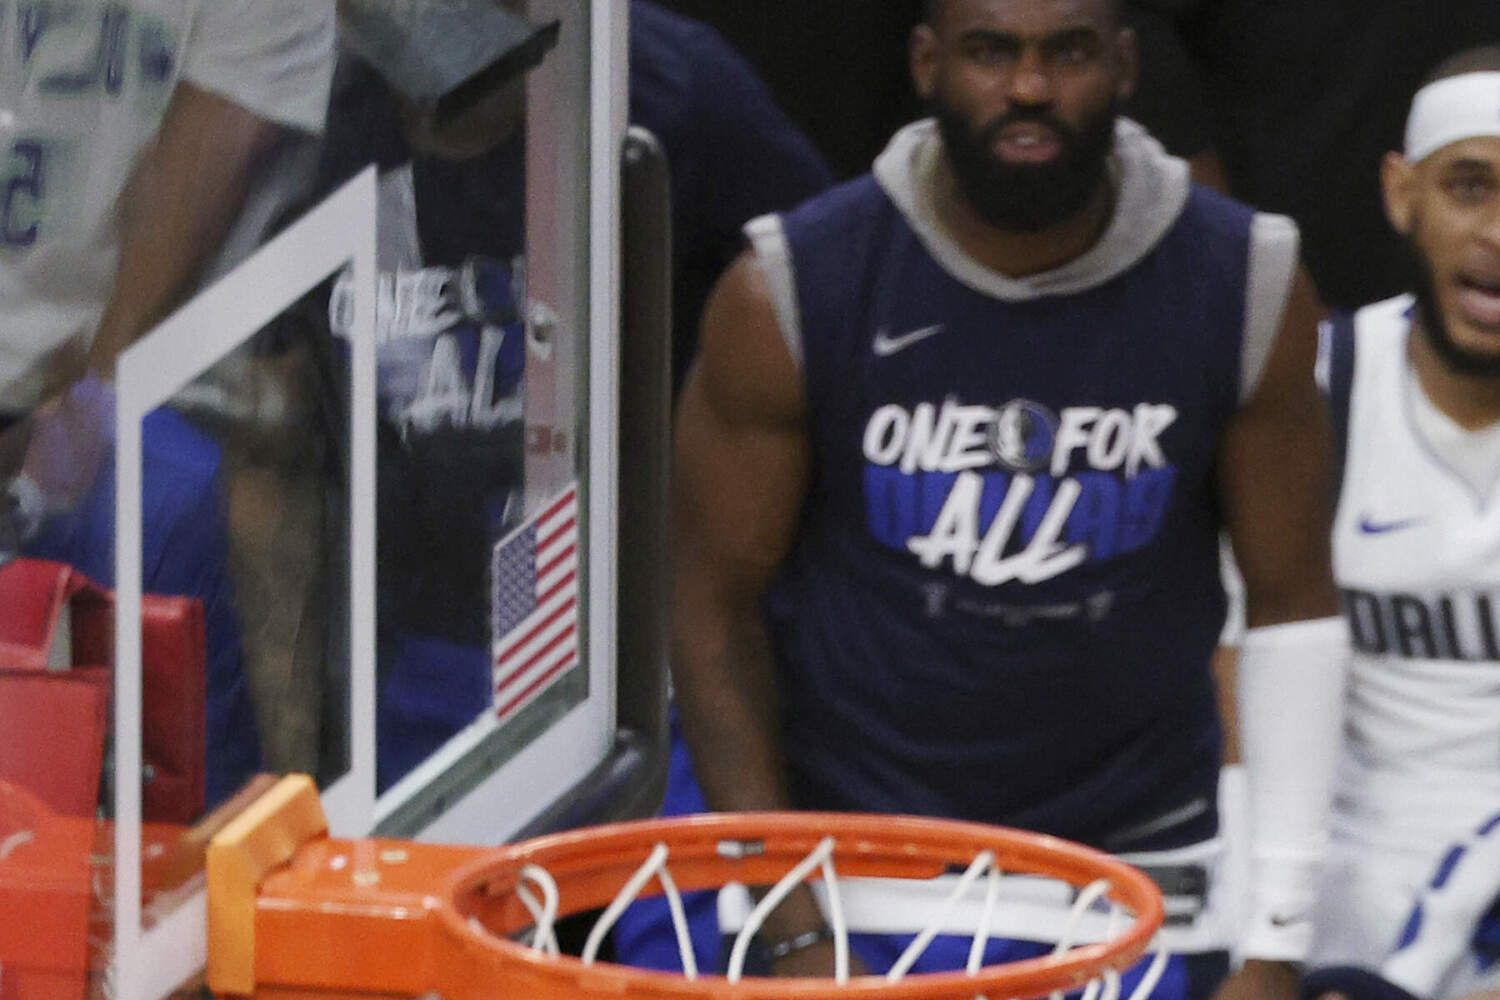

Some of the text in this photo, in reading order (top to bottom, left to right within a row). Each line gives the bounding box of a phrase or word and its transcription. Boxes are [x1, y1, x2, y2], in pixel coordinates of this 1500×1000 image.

[862, 396, 1178, 478] ONE FOR
[906, 471, 1086, 585] ALL
